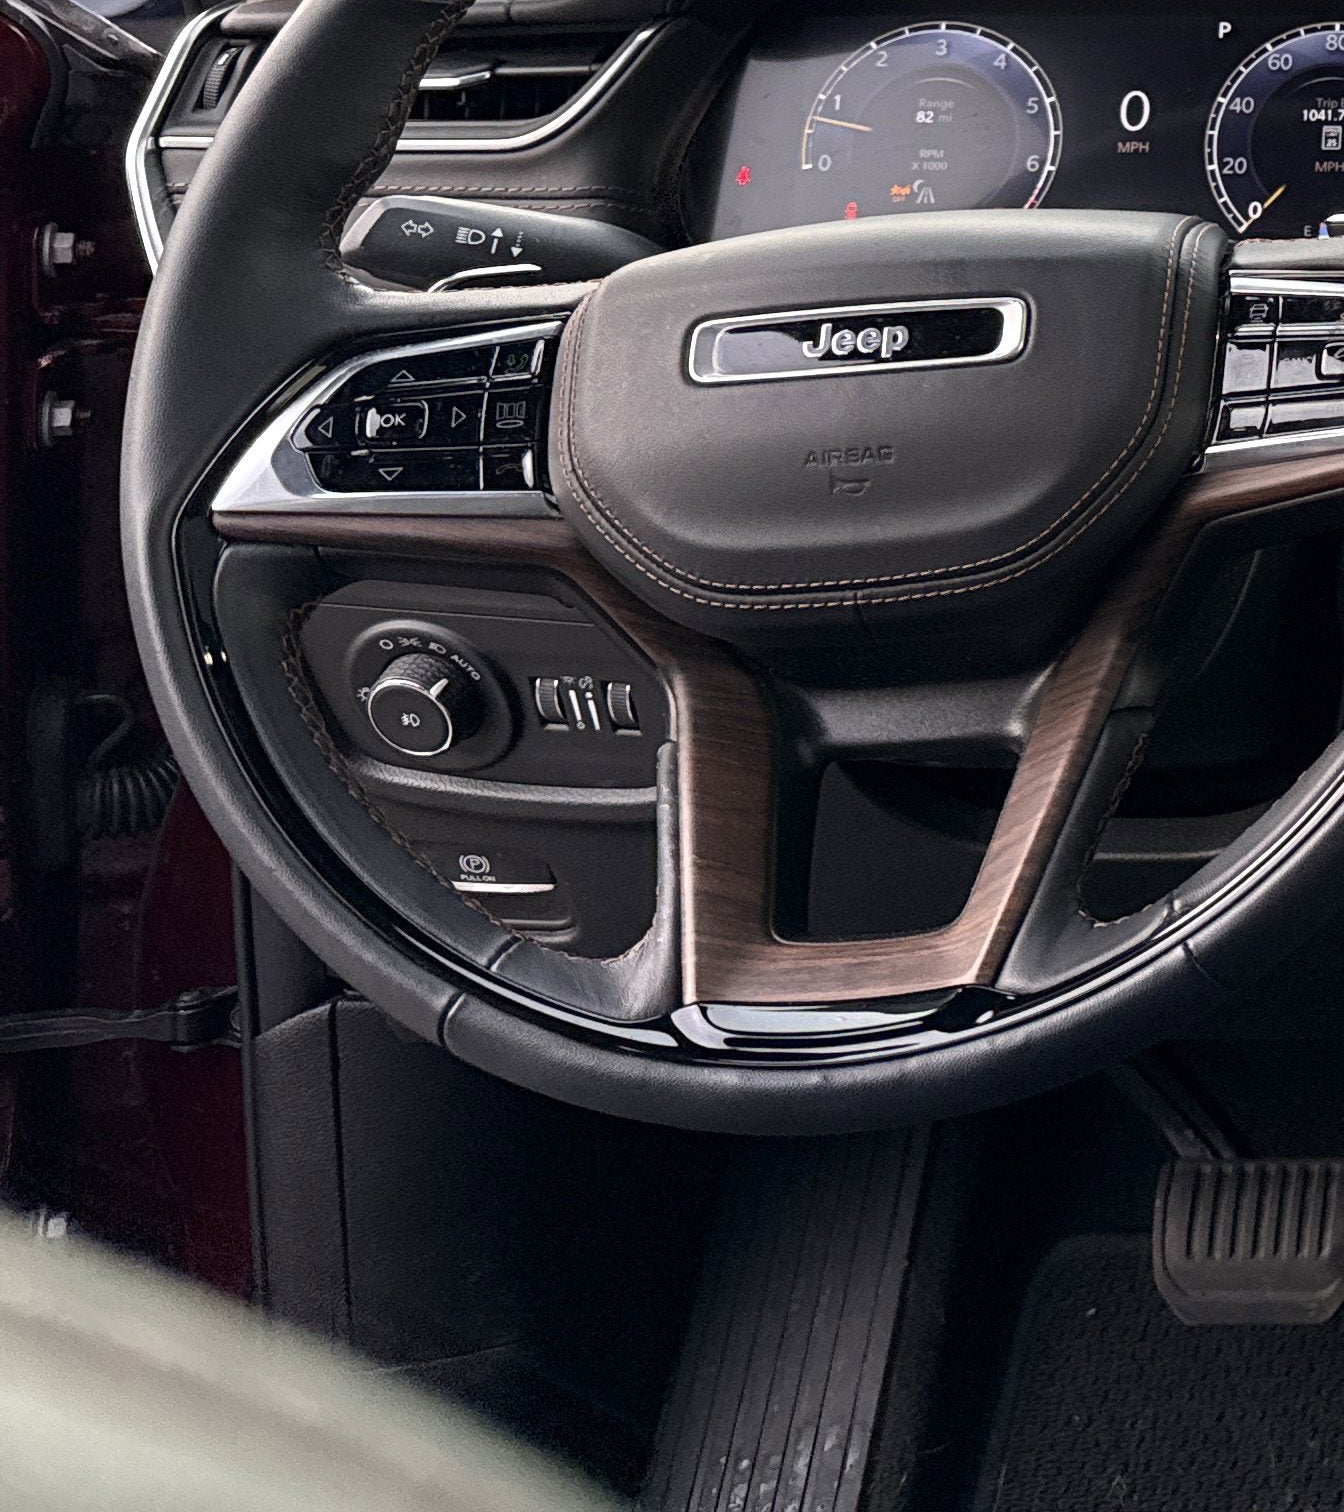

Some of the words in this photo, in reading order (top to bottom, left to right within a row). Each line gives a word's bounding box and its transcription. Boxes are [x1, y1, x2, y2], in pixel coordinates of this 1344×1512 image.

[1218, 21, 1232, 39] P
[935, 39, 948, 56] 3
[875, 51, 889, 67] 2
[993, 53, 1008, 69] 4
[1266, 53, 1293, 71] 60
[833, 94, 843, 111] 1
[918, 98, 955, 111] Range
[1025, 97, 1039, 114] 5
[1120, 90, 1150, 131] 0
[1228, 96, 1255, 115] 40
[1316, 97, 1339, 110] Trip
[915, 110, 935, 123] 82
[938, 111, 953, 123] mi
[918, 149, 945, 159] RPM
[1117, 141, 1150, 154] MPH
[817, 154, 833, 172] 0
[922, 160, 949, 171] 1000
[1025, 155, 1040, 172] 6
[1221, 156, 1248, 174] 20
[1247, 200, 1261, 220] 0
[1303, 224, 1312, 237] E
[802, 322, 910, 359] Jeep
[380, 412, 407, 428] OK
[804, 445, 897, 468] AIRBAG
[451, 654, 481, 681] AUTO
